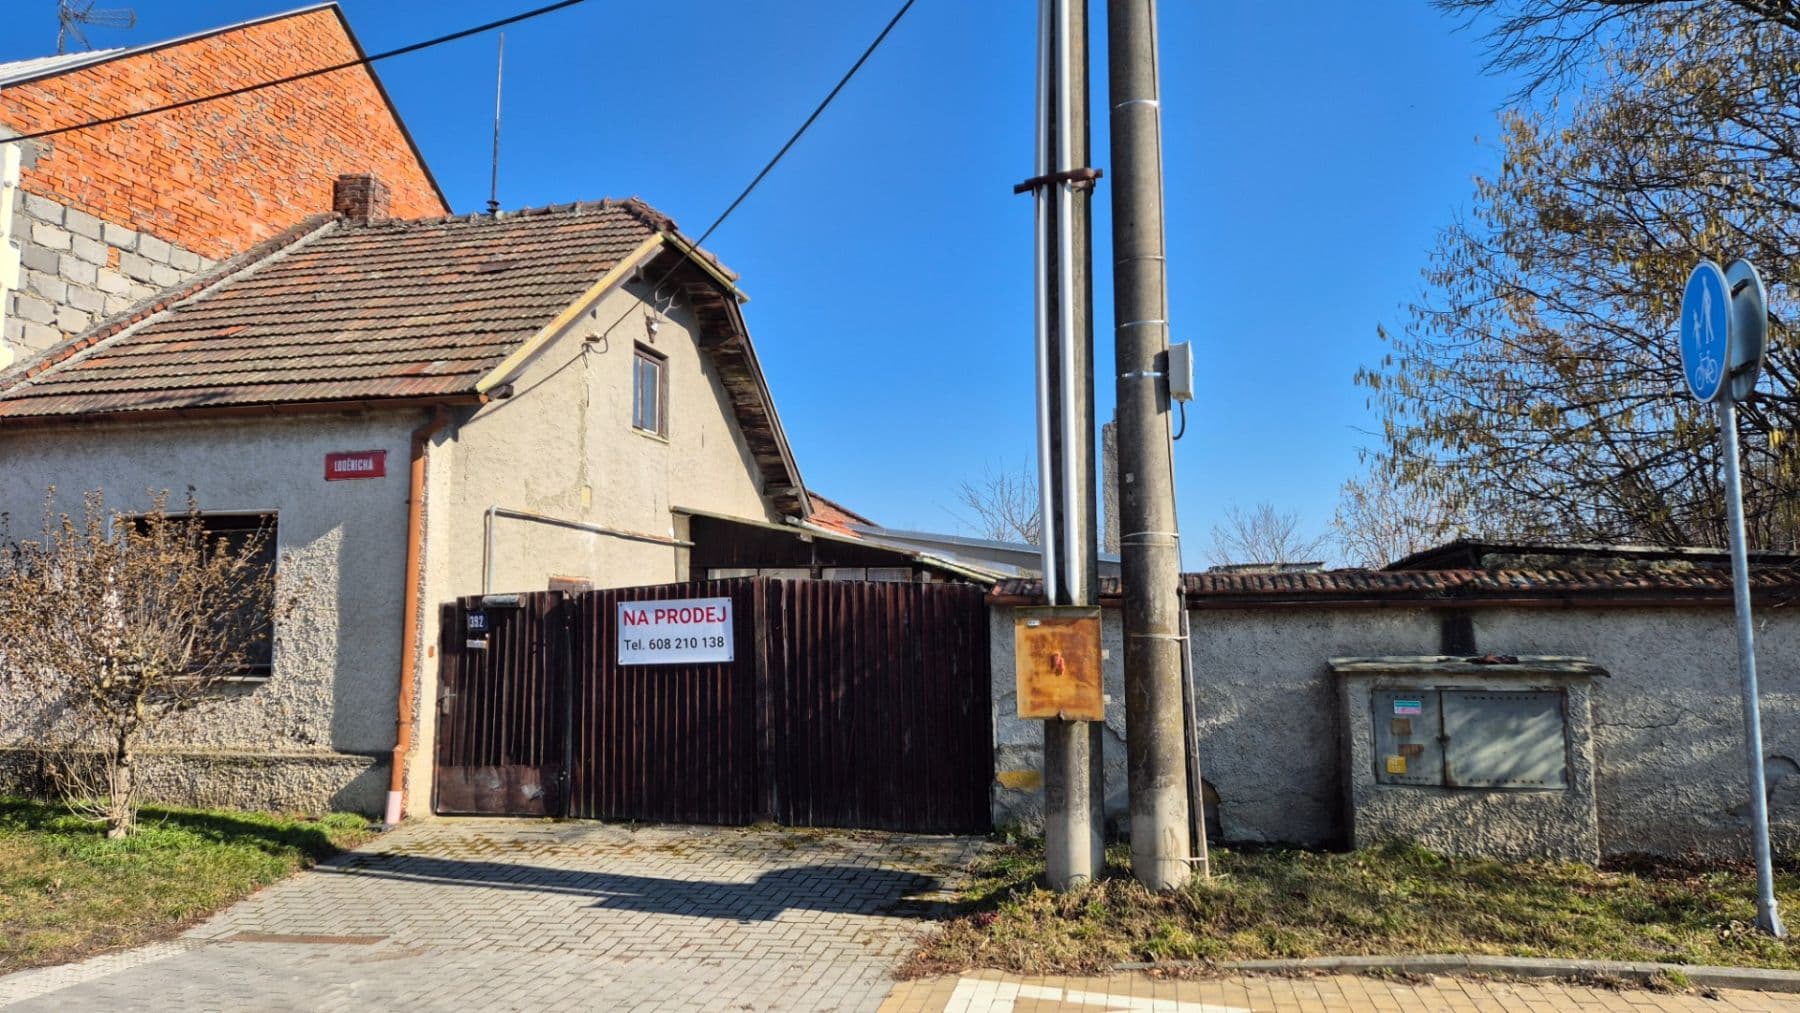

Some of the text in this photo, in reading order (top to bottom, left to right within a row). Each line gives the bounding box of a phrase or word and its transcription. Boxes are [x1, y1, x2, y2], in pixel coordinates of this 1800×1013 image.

[469, 615, 484, 628] 392
[623, 606, 727, 626] NA PRODEJ
[624, 636, 725, 651] Tel. 608 210 138
